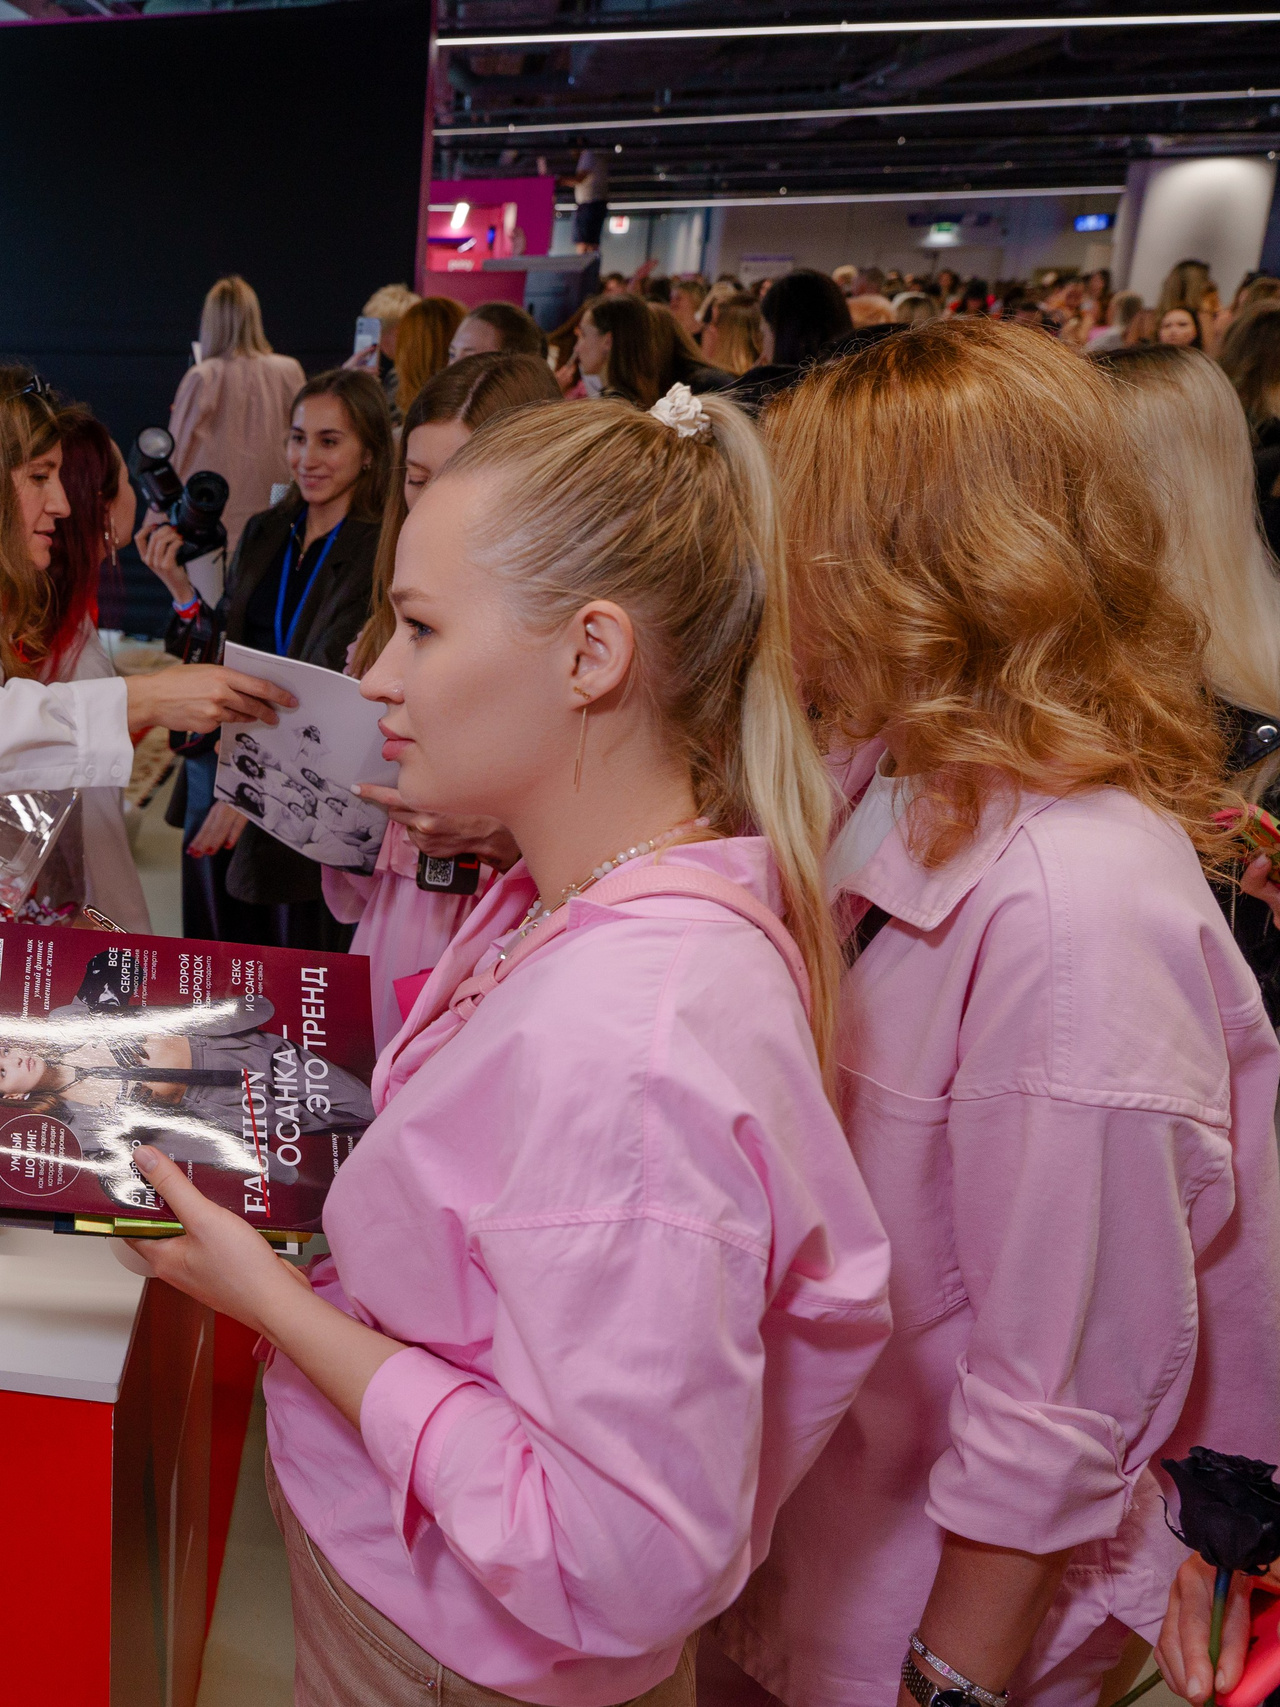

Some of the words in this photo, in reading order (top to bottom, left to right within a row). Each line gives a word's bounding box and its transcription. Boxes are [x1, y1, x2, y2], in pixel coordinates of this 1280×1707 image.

[25, 954, 33, 973] том,
[34, 939, 43, 970] фитнес
[45, 940, 54, 967] жизнь
[107, 946, 118, 966] ВСЕ
[33, 971, 41, 998] умный
[45, 967, 51, 976] ее
[120, 947, 131, 993] СЕКРЕТЫ
[179, 953, 189, 994] ВТОРОЙ
[231, 958, 241, 985] СЕКС
[244, 959, 254, 1002] ОСАНКА
[43, 977, 51, 1010] изменил
[245, 1003, 254, 1011] И
[301, 964, 328, 1051] ТРЕНД
[305, 1057, 330, 1114] ЭТО
[273, 1046, 300, 1166] ОСАНКА
